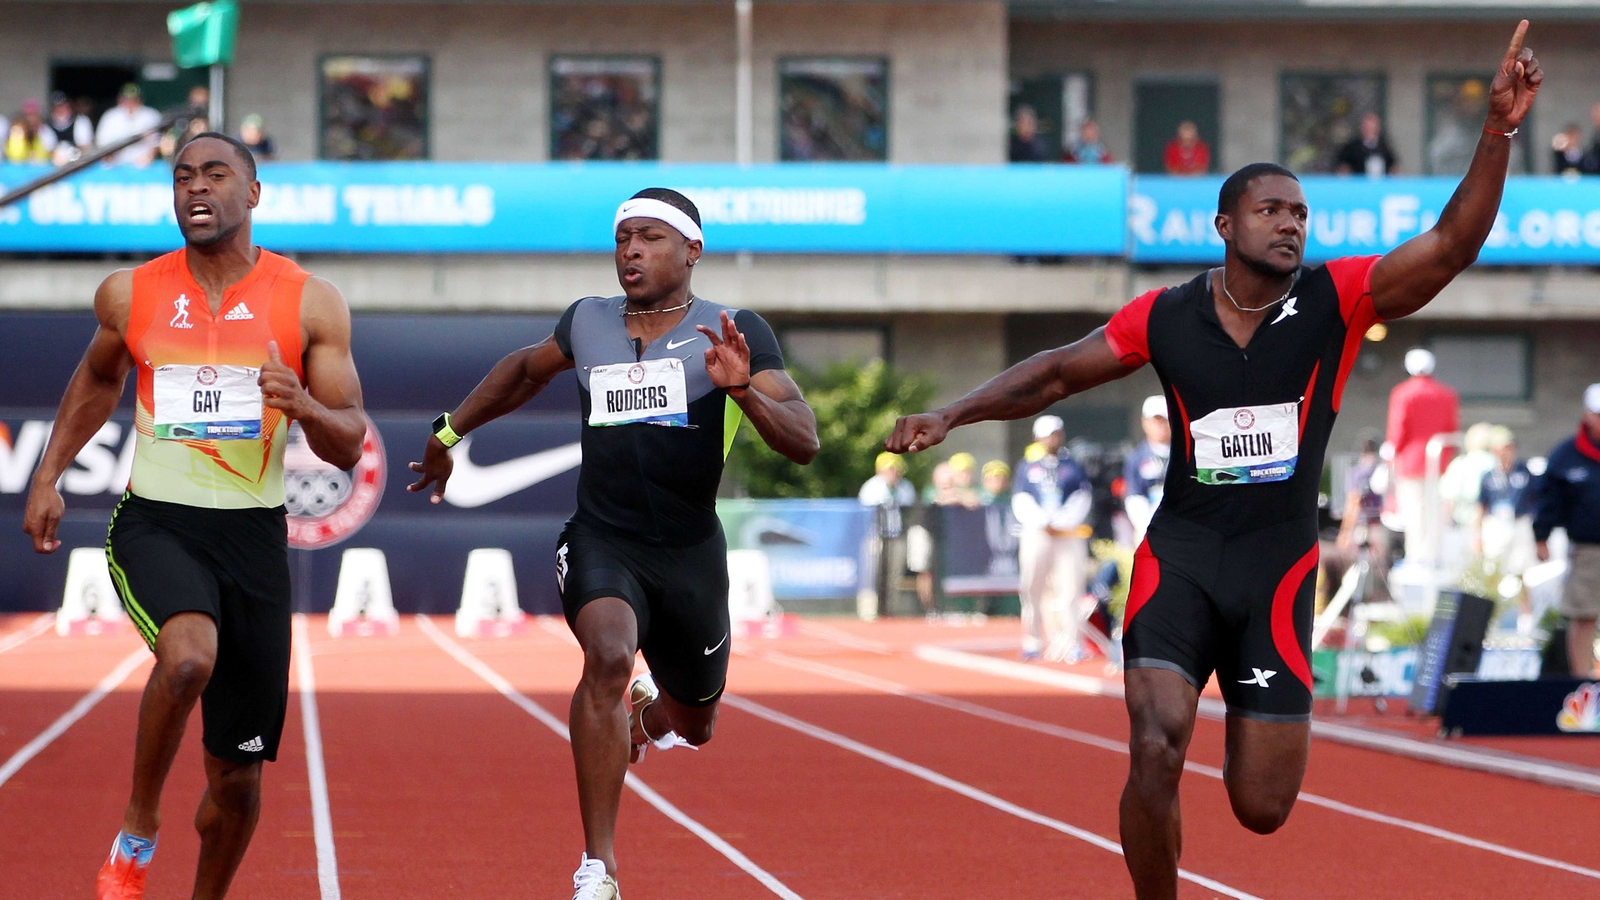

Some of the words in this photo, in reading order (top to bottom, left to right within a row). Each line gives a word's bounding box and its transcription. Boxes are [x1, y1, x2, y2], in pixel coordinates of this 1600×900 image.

[29, 183, 176, 225] OLYMP
[251, 184, 336, 225] EAM
[343, 184, 495, 226] TRIALS
[224, 313, 255, 321] adidas
[193, 390, 222, 413] GAY
[606, 385, 668, 413] RODGERS
[1220, 432, 1273, 458] GATLIN
